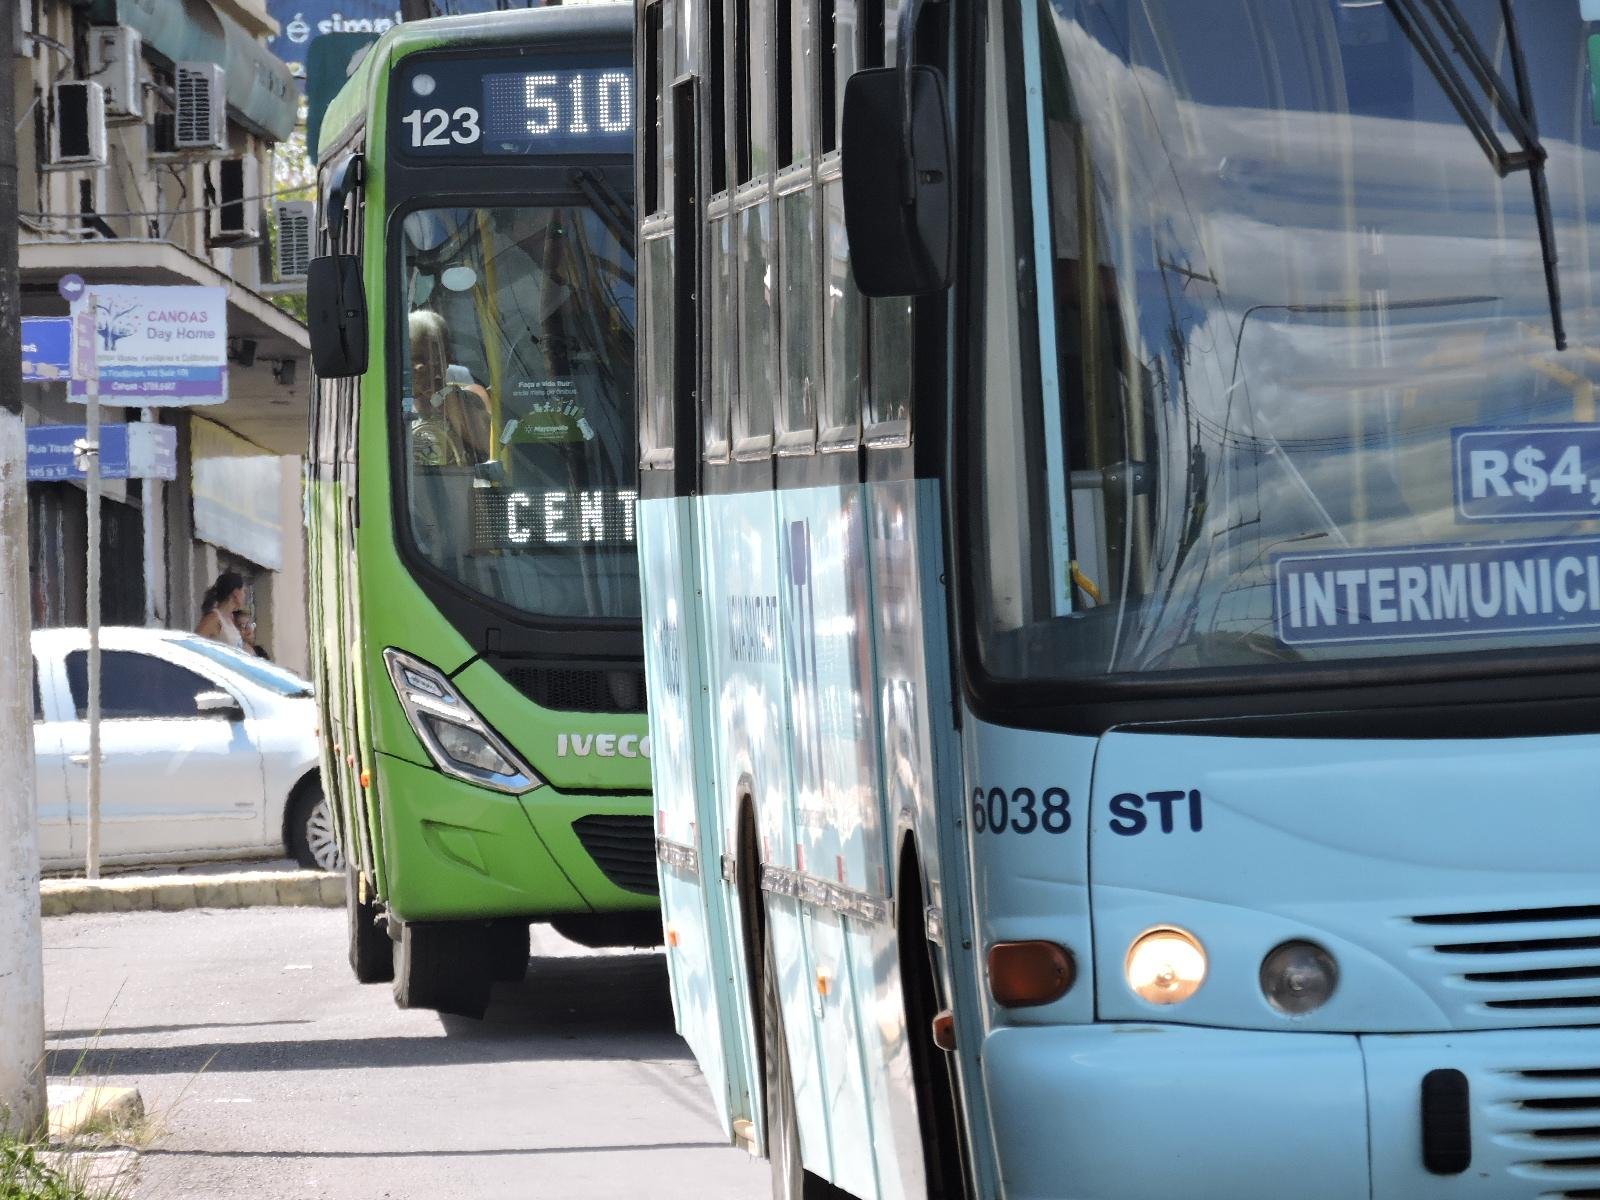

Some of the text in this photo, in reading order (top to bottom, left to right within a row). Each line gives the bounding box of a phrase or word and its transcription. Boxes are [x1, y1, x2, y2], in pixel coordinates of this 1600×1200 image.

[402, 106, 480, 147] 123
[525, 73, 630, 134] 510
[147, 311, 208, 323] CANOAS
[147, 327, 216, 342] Day Home
[1470, 444, 1600, 506] R$4,
[507, 491, 638, 543] CENT
[1287, 555, 1600, 628] INTERMUNICI
[973, 787, 1072, 835] 6038
[1109, 788, 1203, 837] STI
